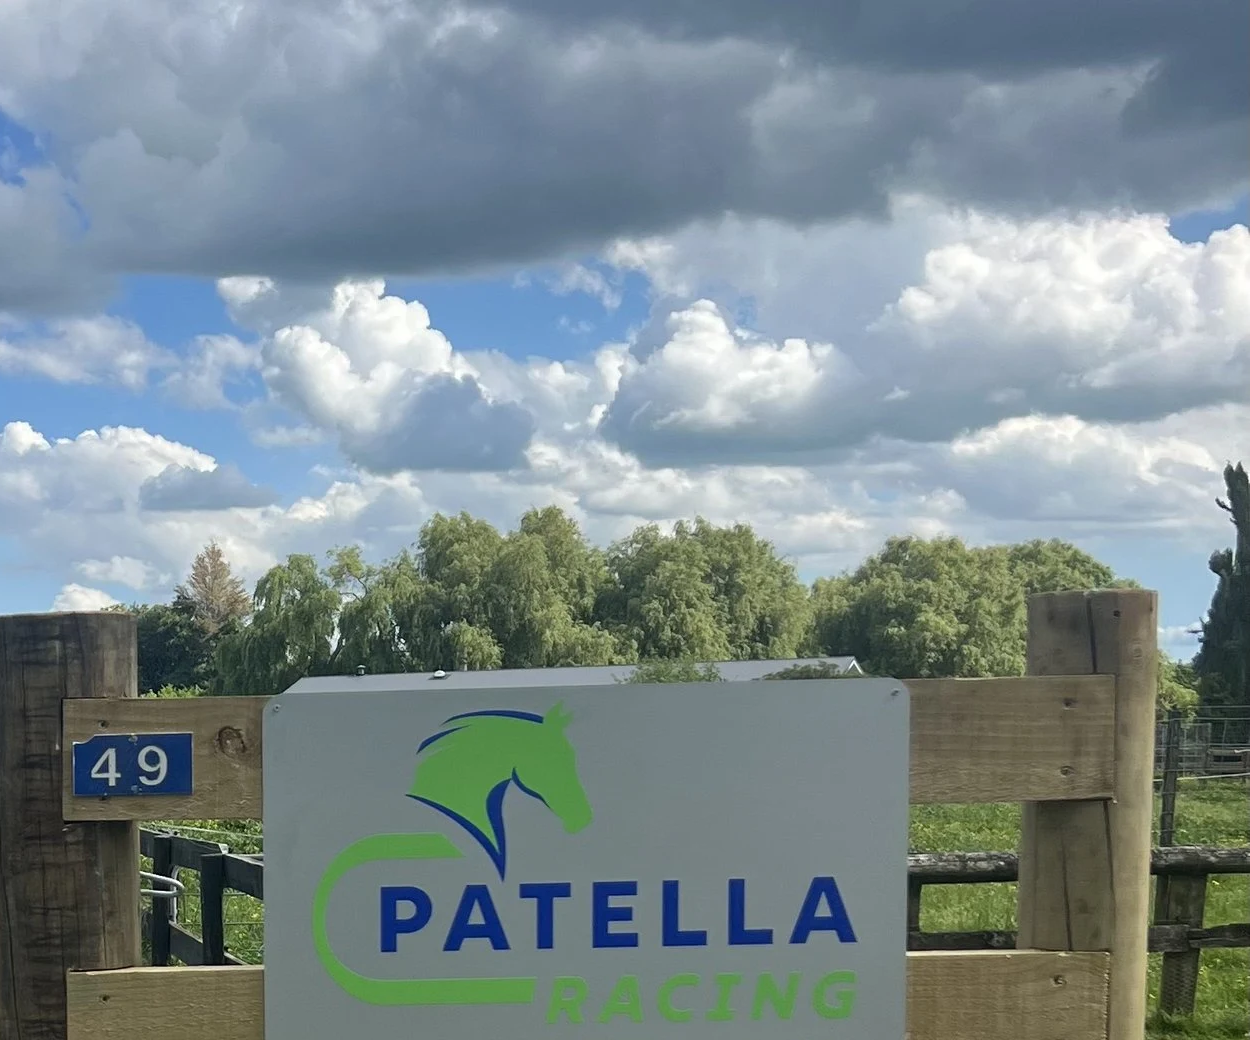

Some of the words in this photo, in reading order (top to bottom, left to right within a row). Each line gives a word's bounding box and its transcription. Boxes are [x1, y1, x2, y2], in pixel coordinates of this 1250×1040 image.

[90, 745, 168, 787] 49
[379, 876, 858, 953] PATELLA
[545, 969, 857, 1024] RACING
